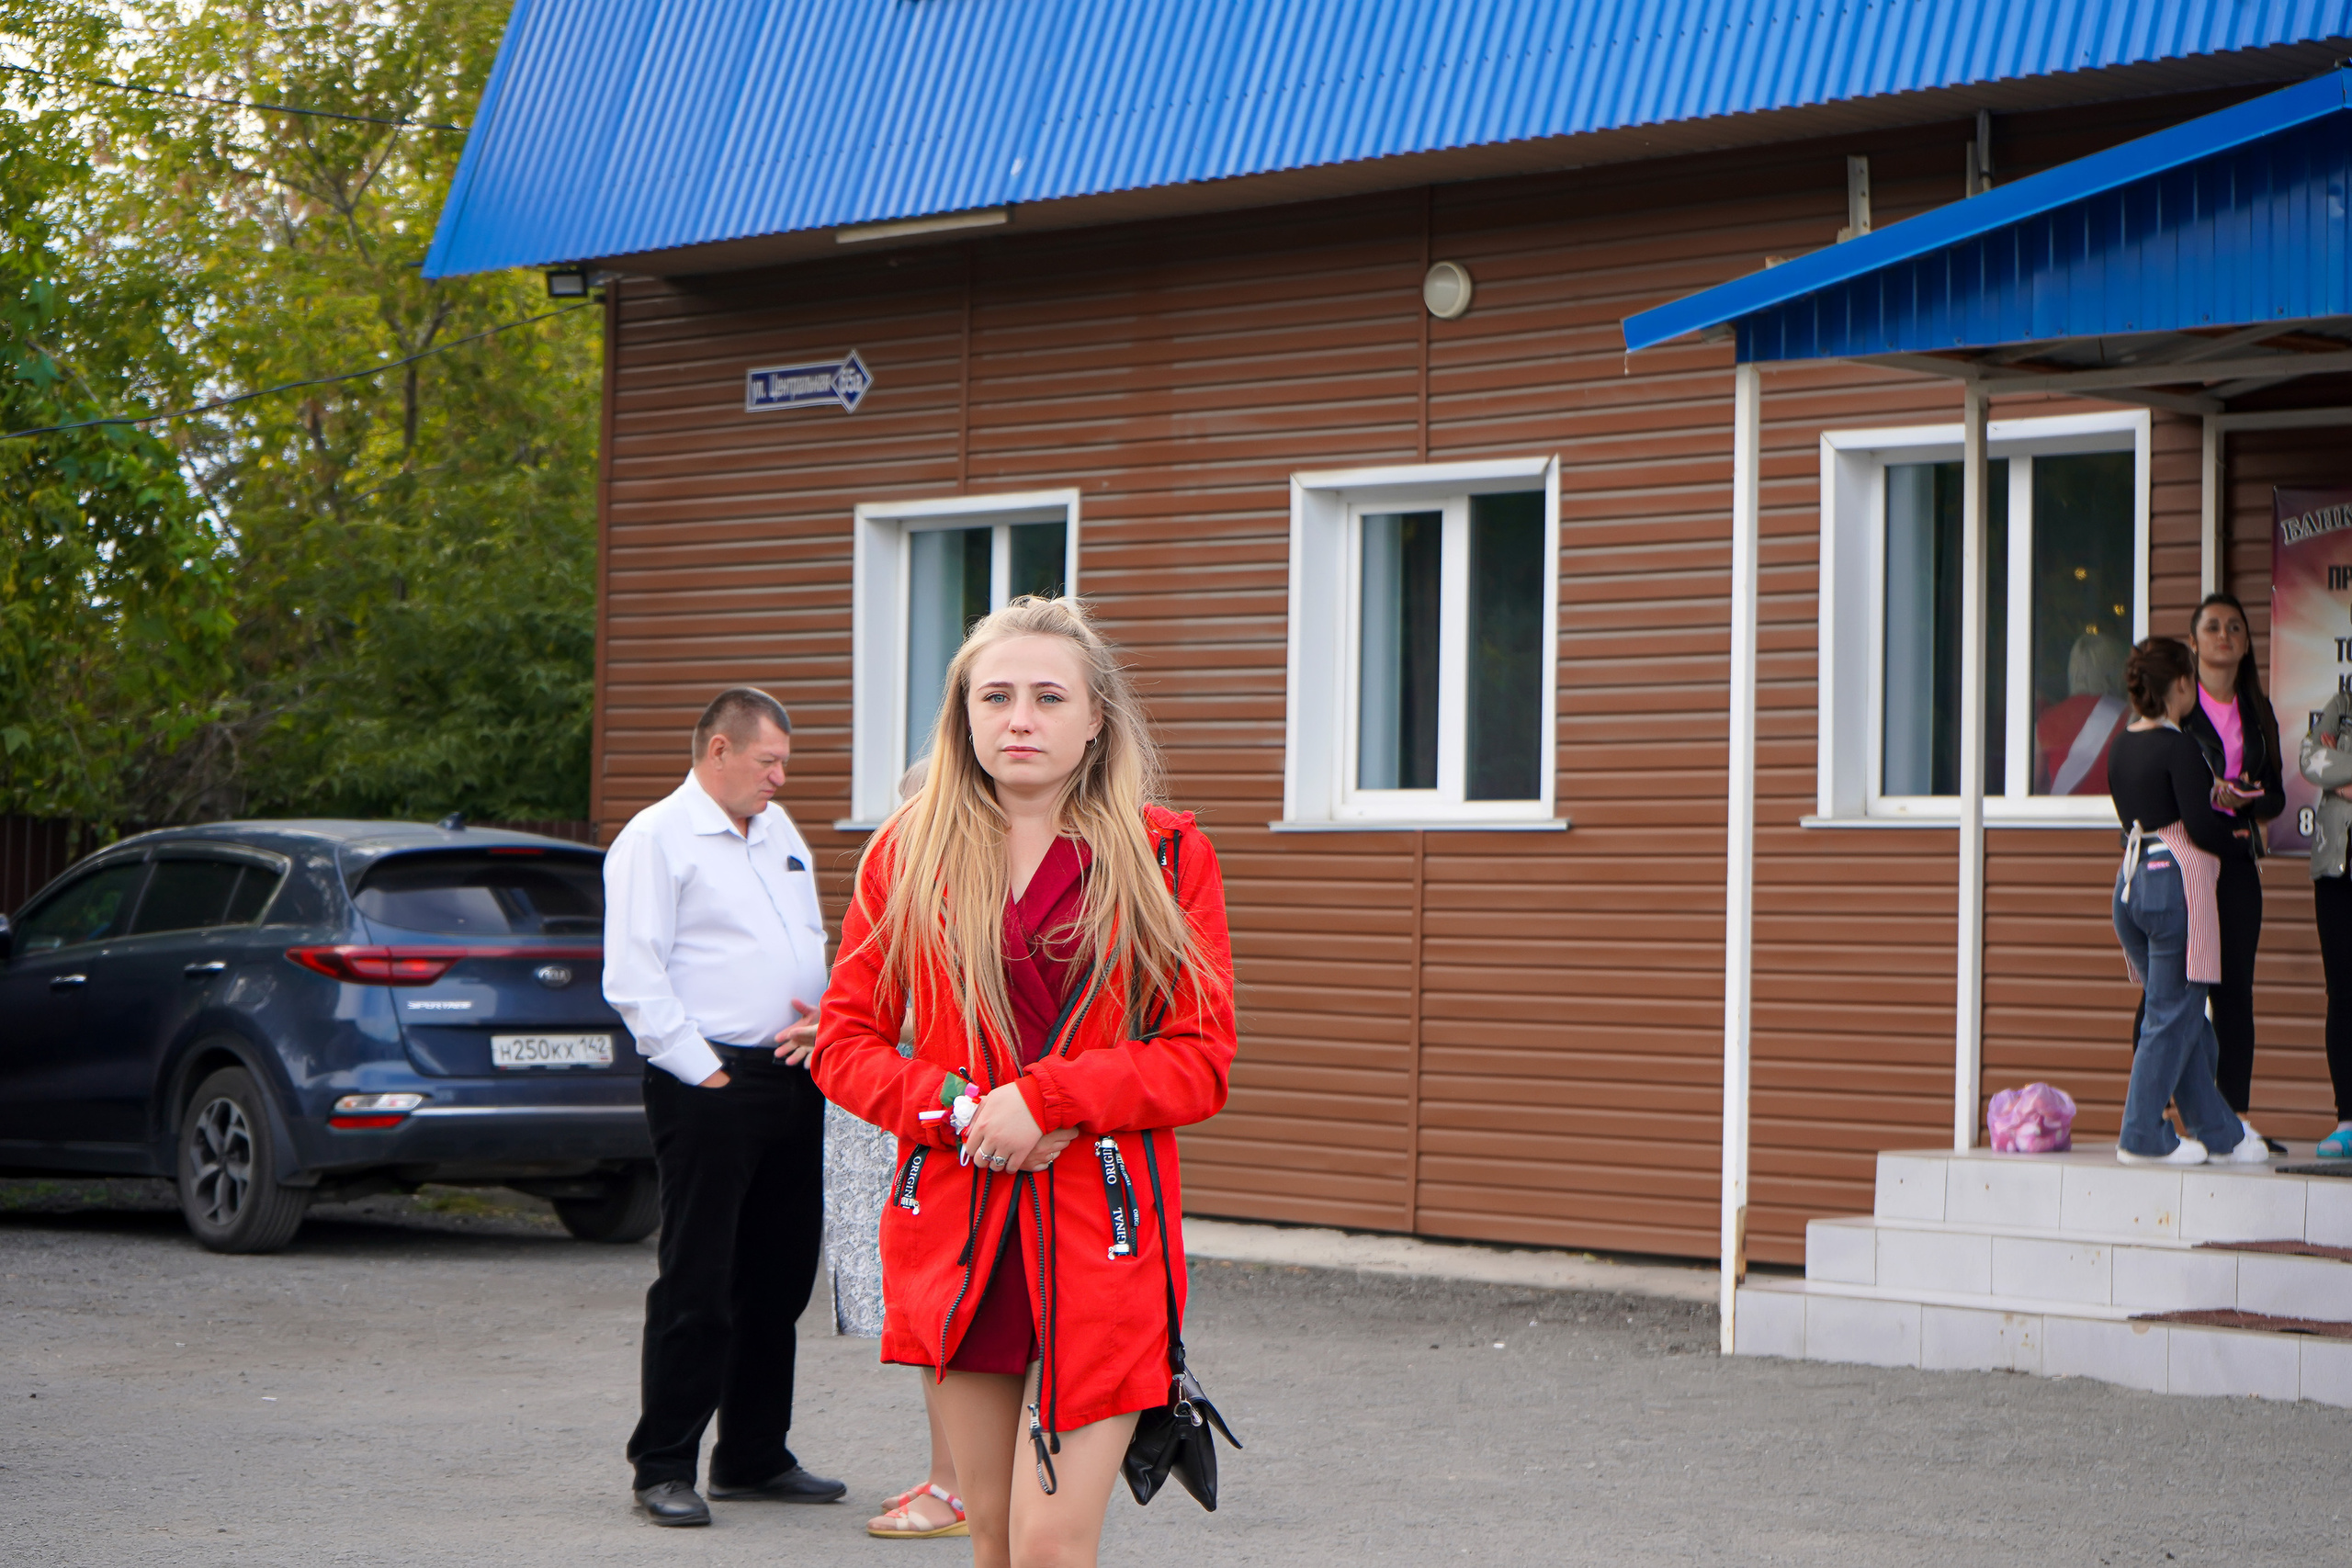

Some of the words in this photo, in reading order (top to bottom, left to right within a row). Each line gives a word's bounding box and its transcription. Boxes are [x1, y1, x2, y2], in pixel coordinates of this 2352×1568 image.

[751, 379, 766, 404] ул.
[768, 373, 831, 402] Центральная
[580, 1035, 606, 1054] 142
